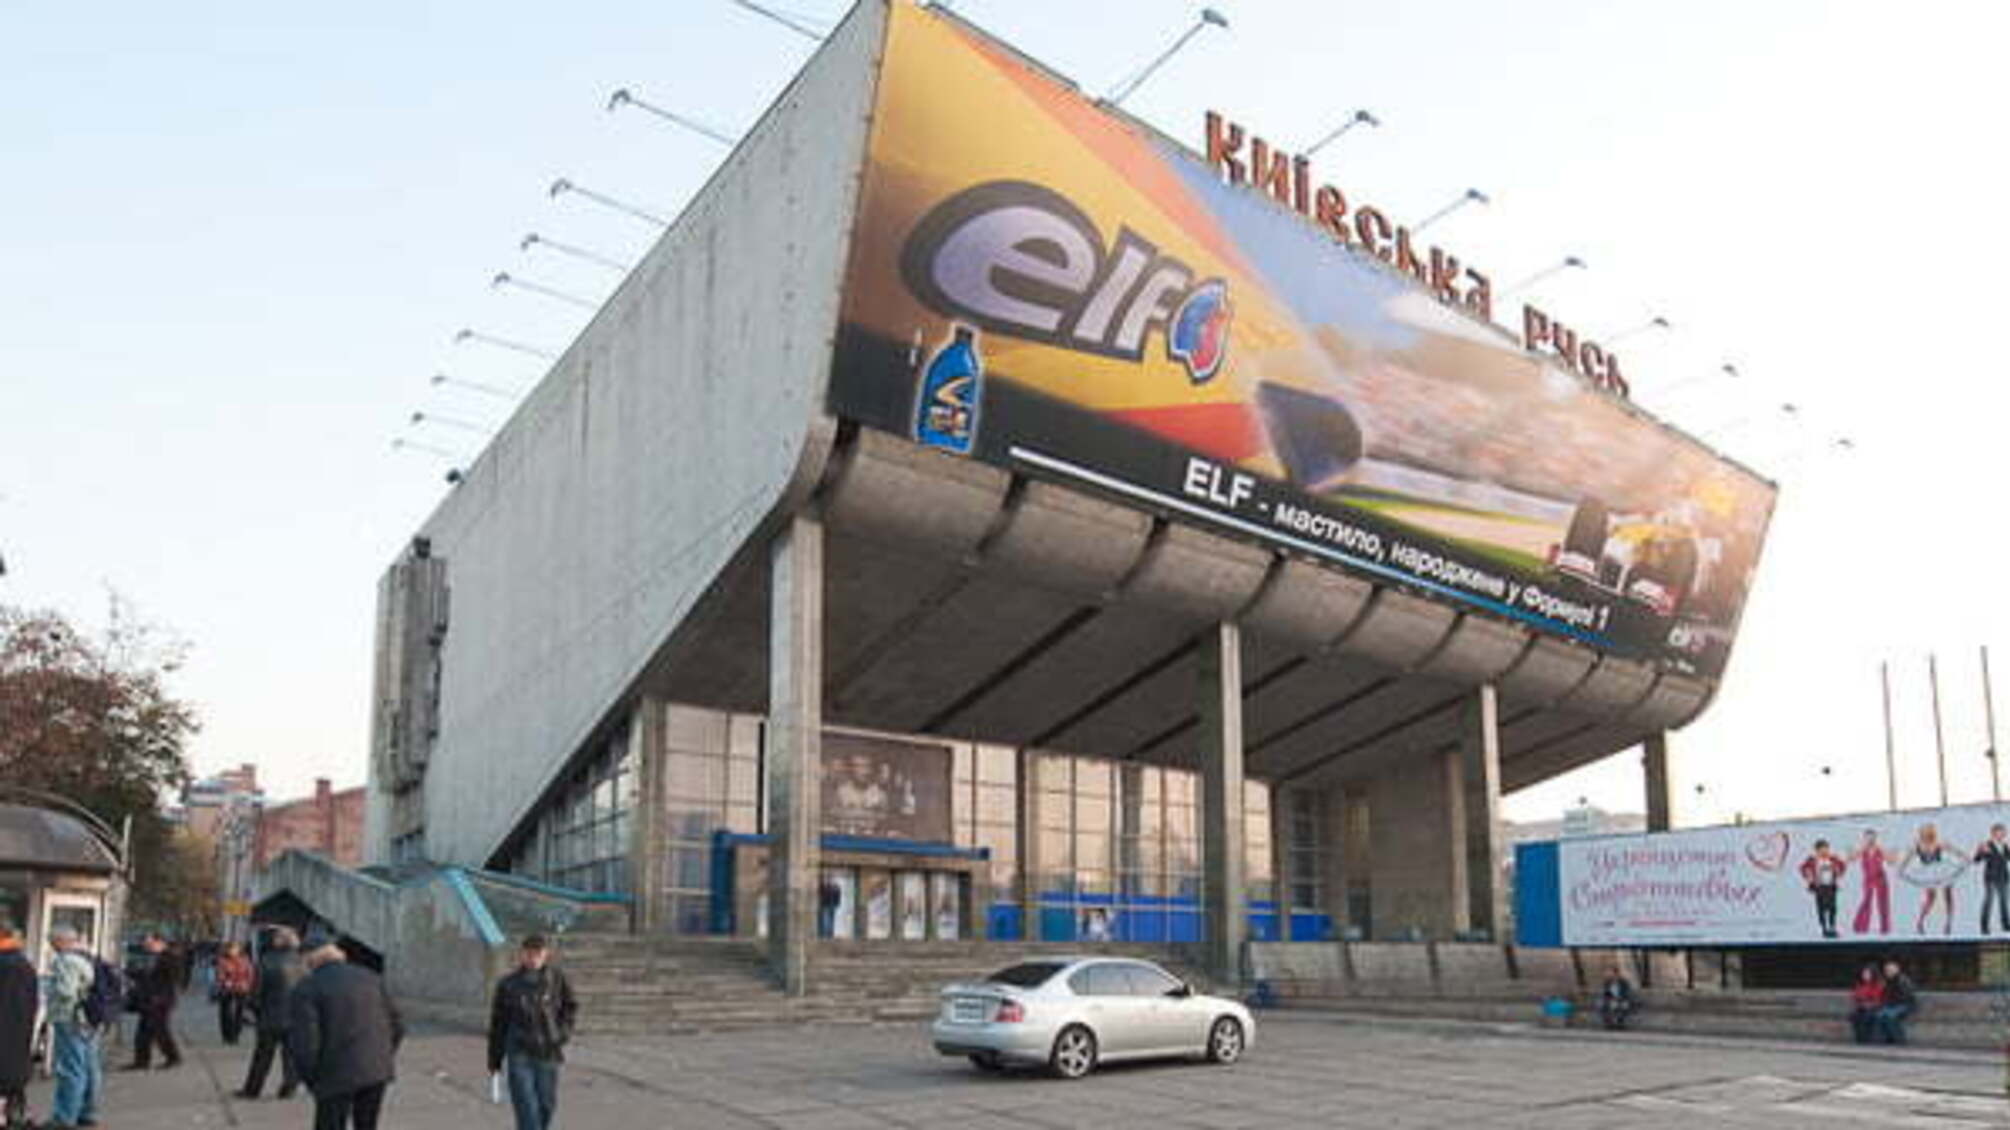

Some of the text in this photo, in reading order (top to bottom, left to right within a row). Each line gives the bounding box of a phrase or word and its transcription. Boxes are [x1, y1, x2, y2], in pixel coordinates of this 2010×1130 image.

[922, 198, 1190, 354] elf
[1184, 457, 1255, 510] ELF
[1274, 502, 1384, 562] мастило,
[1506, 581, 1521, 605] у
[1597, 606, 1609, 631] 1
